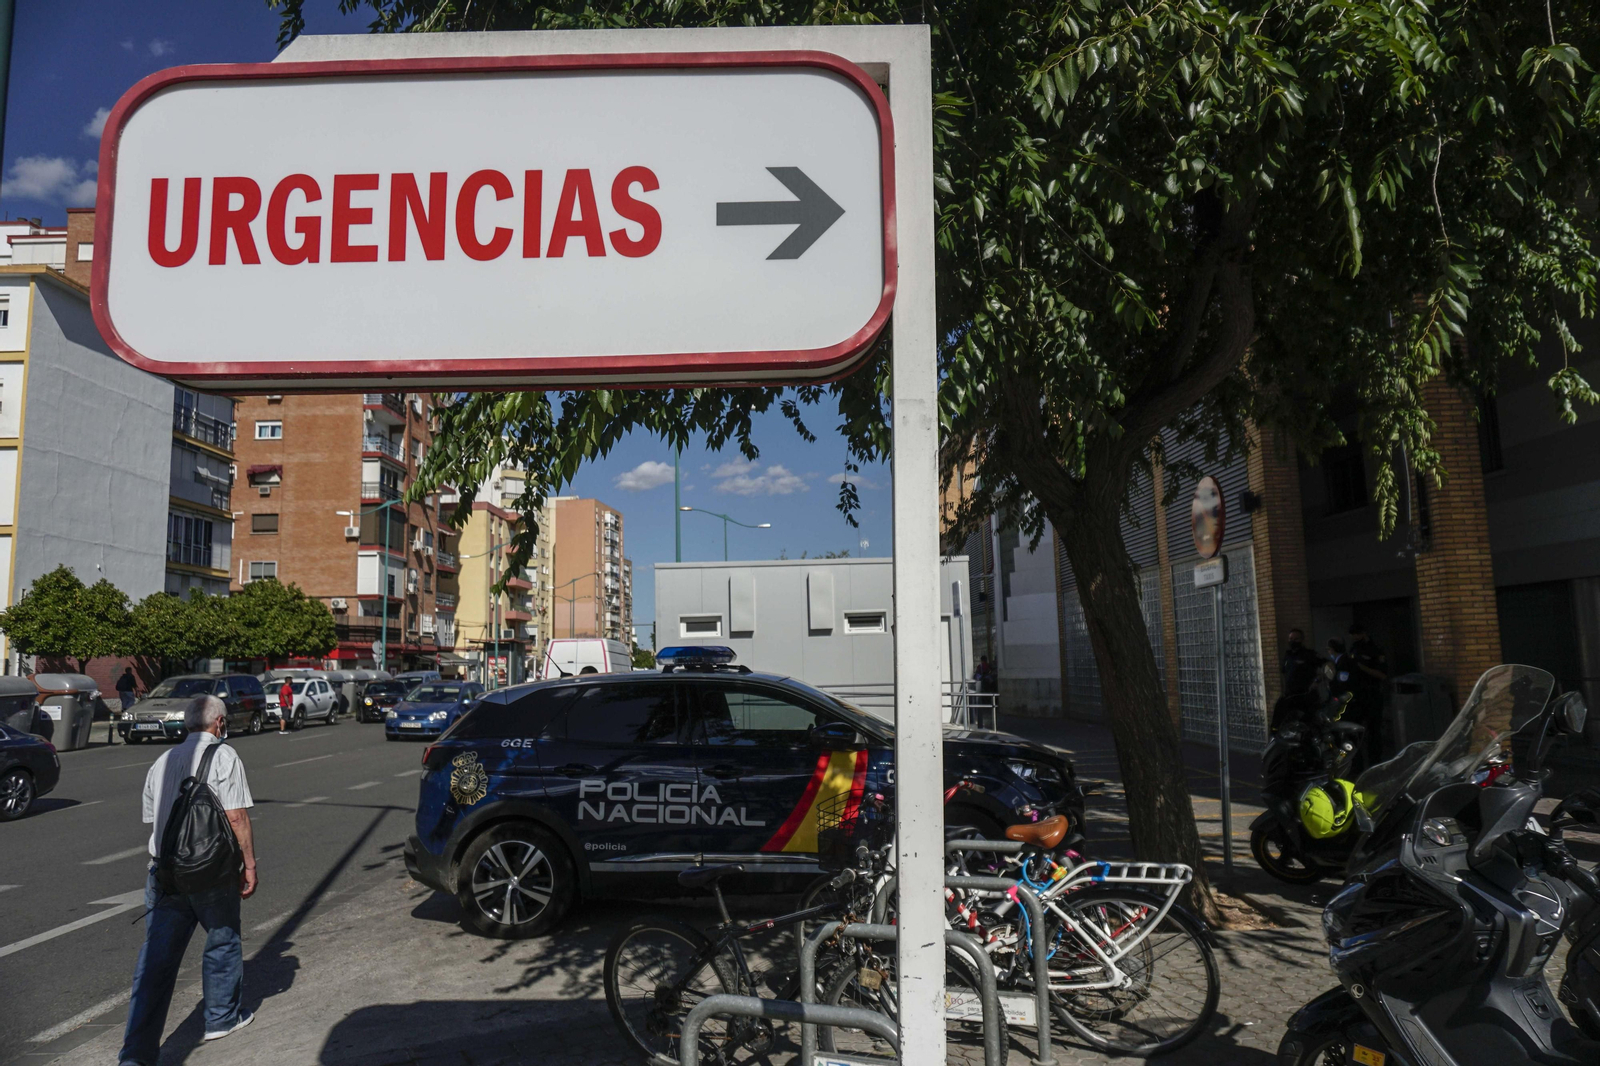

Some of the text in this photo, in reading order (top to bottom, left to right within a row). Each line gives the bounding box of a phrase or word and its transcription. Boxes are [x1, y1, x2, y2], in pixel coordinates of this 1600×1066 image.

[147, 165, 663, 268] URGENCIAS
[500, 738, 534, 749] 6GE
[579, 780, 723, 804] POLICIA
[577, 801, 766, 827] NACIONAL
[584, 842, 627, 851] @policia
